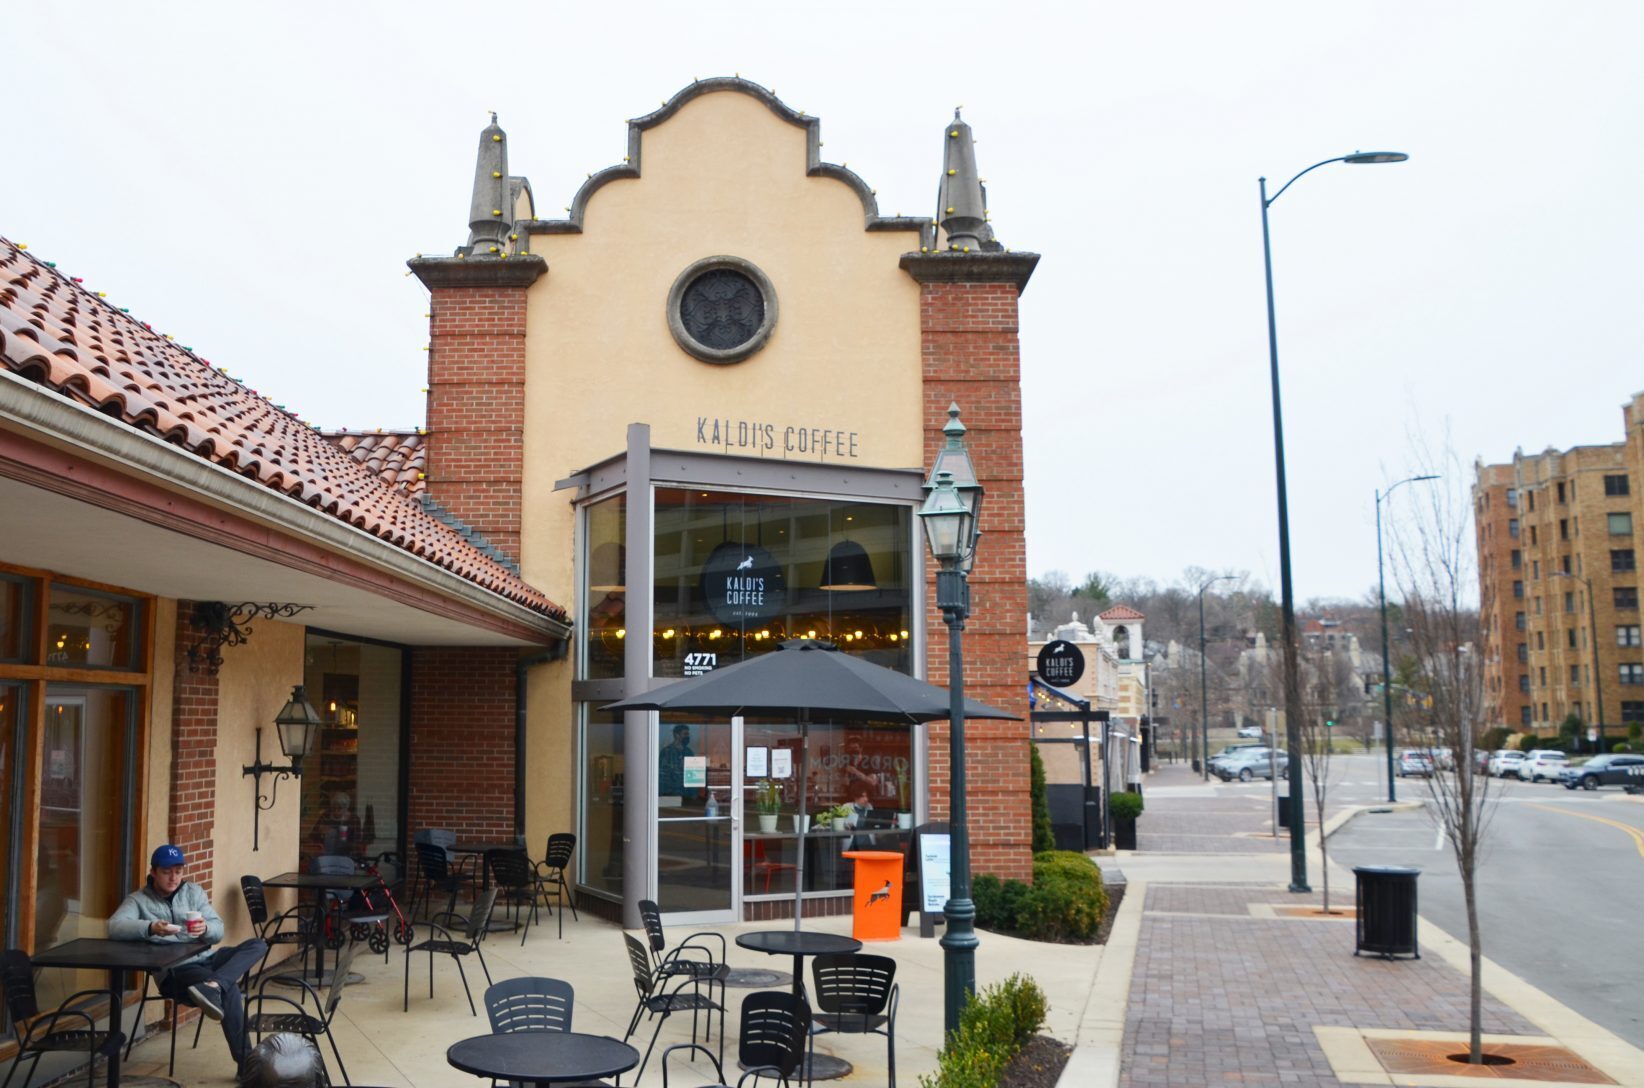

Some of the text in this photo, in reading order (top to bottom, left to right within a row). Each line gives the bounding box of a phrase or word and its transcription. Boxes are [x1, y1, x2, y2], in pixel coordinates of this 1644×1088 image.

[697, 416, 858, 458] KALDI'S COFFEE
[726, 576, 764, 591] KALDI'S
[726, 591, 764, 606] COFFEE
[684, 652, 717, 666] 4771
[1045, 657, 1074, 667] KALDI'S
[1045, 667, 1073, 677] COFFEE
[168, 848, 179, 857] KC
